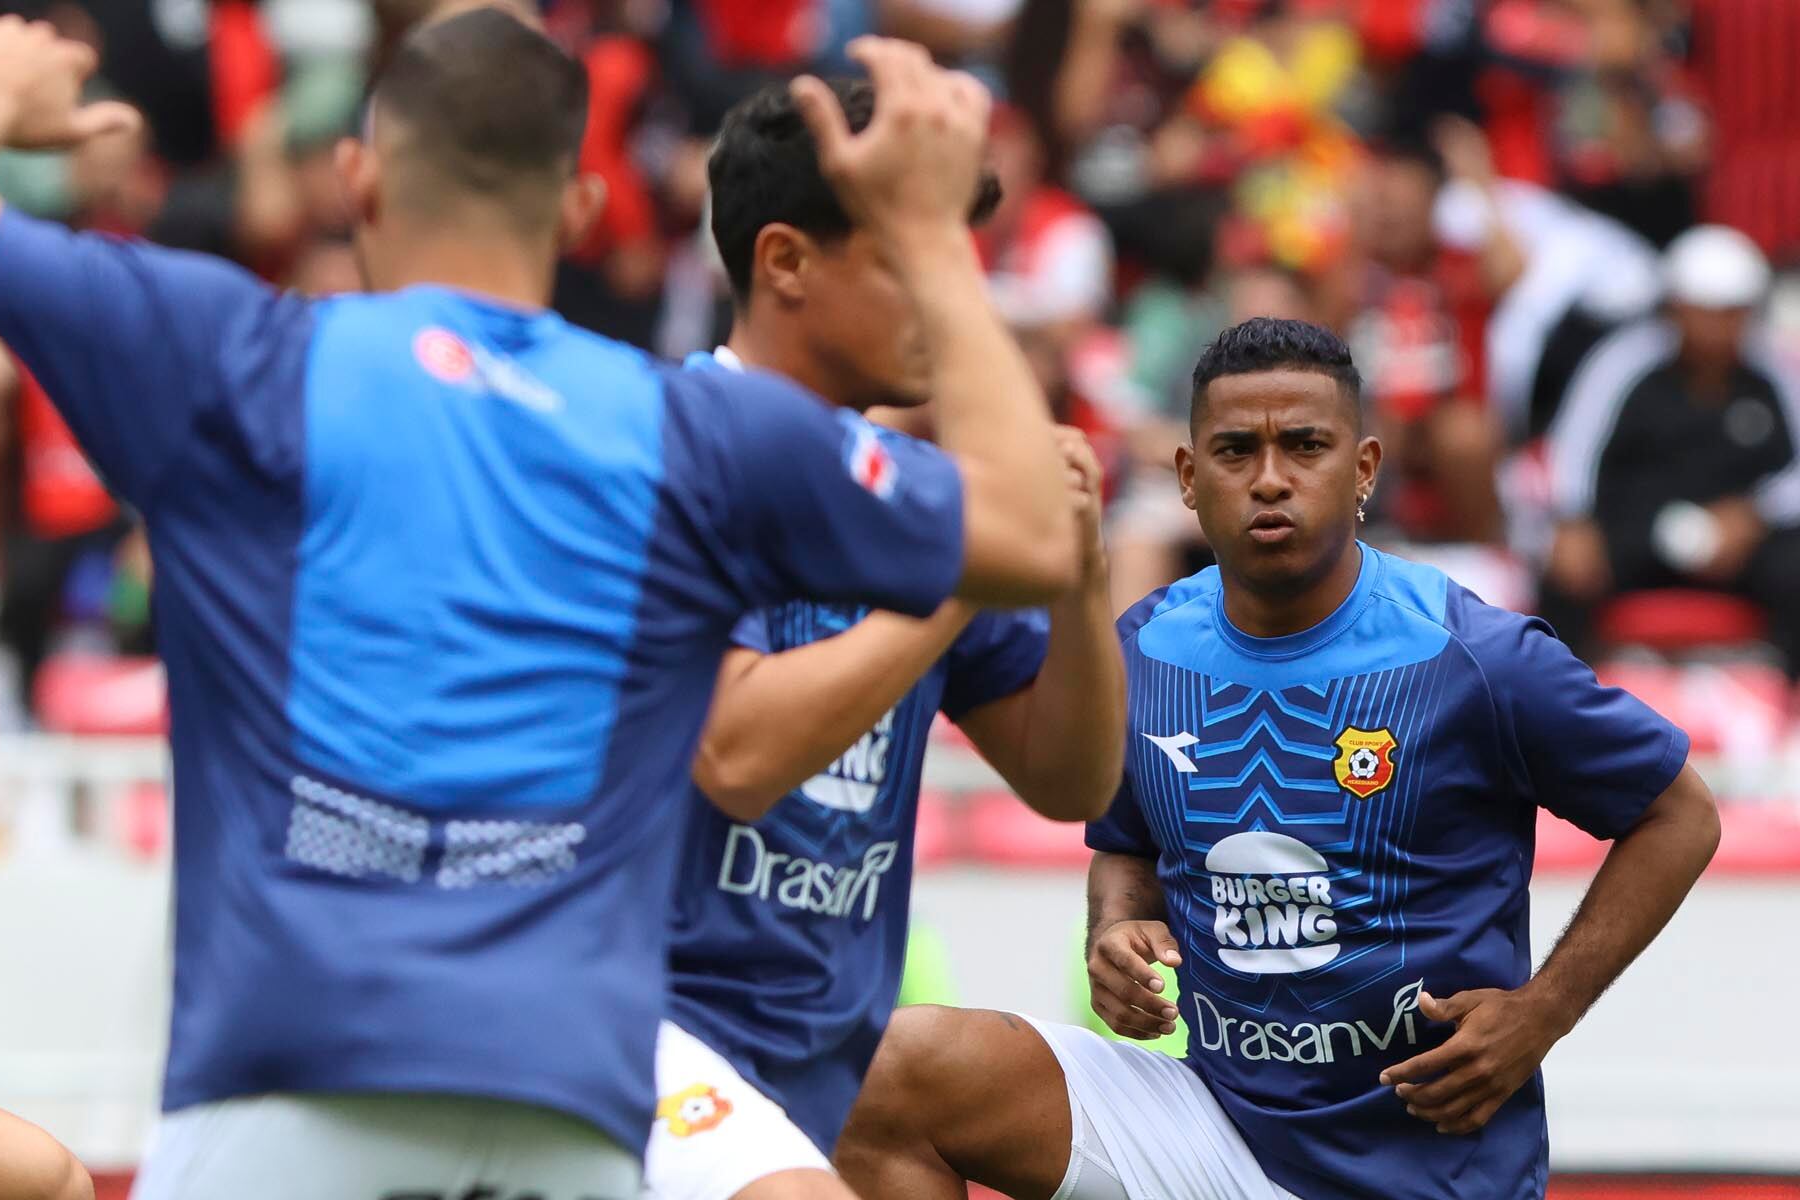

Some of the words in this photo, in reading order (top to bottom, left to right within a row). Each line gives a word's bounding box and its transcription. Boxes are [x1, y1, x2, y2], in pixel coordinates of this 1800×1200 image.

[1211, 875, 1332, 906] BURGER
[1214, 903, 1338, 947] KING
[1193, 977, 1424, 1064] Drasanvi
